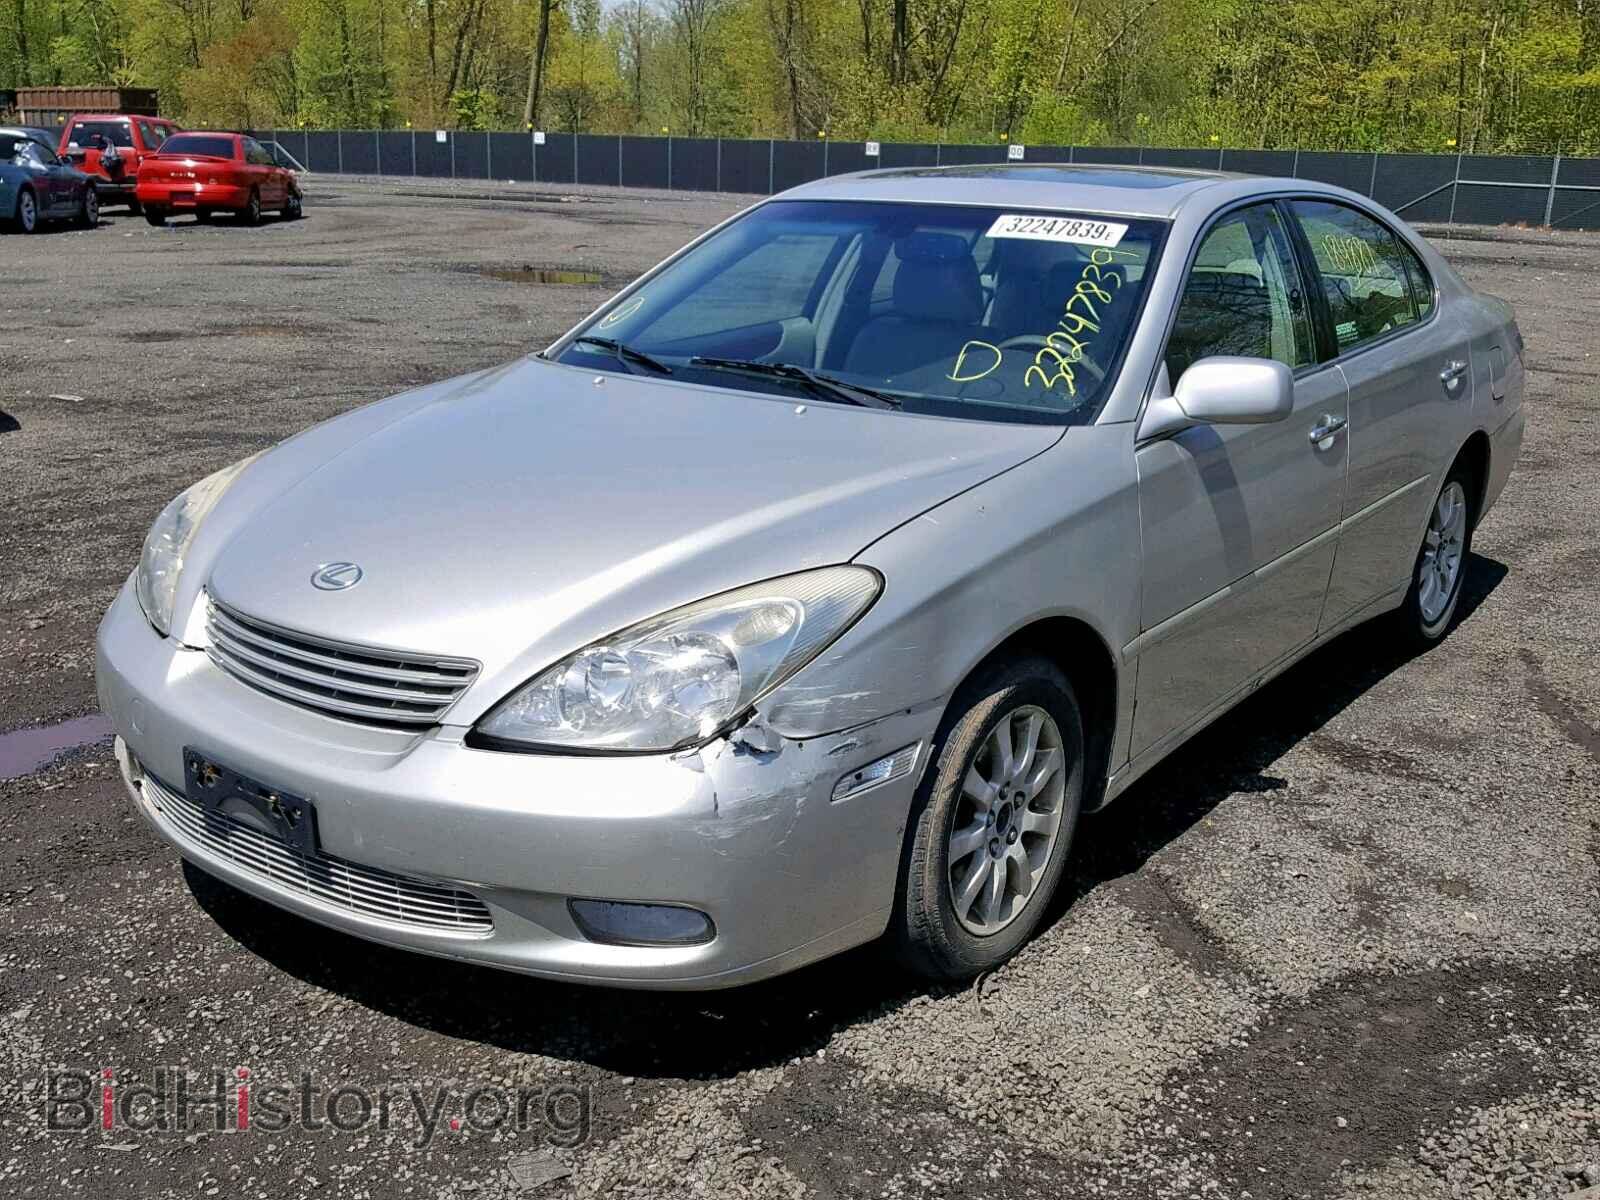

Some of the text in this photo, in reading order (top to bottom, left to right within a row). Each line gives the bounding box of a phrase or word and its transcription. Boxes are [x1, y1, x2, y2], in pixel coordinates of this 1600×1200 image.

[1006, 217, 1108, 240] 32247839
[1024, 248, 1140, 397] 32247839
[945, 340, 1002, 381] D
